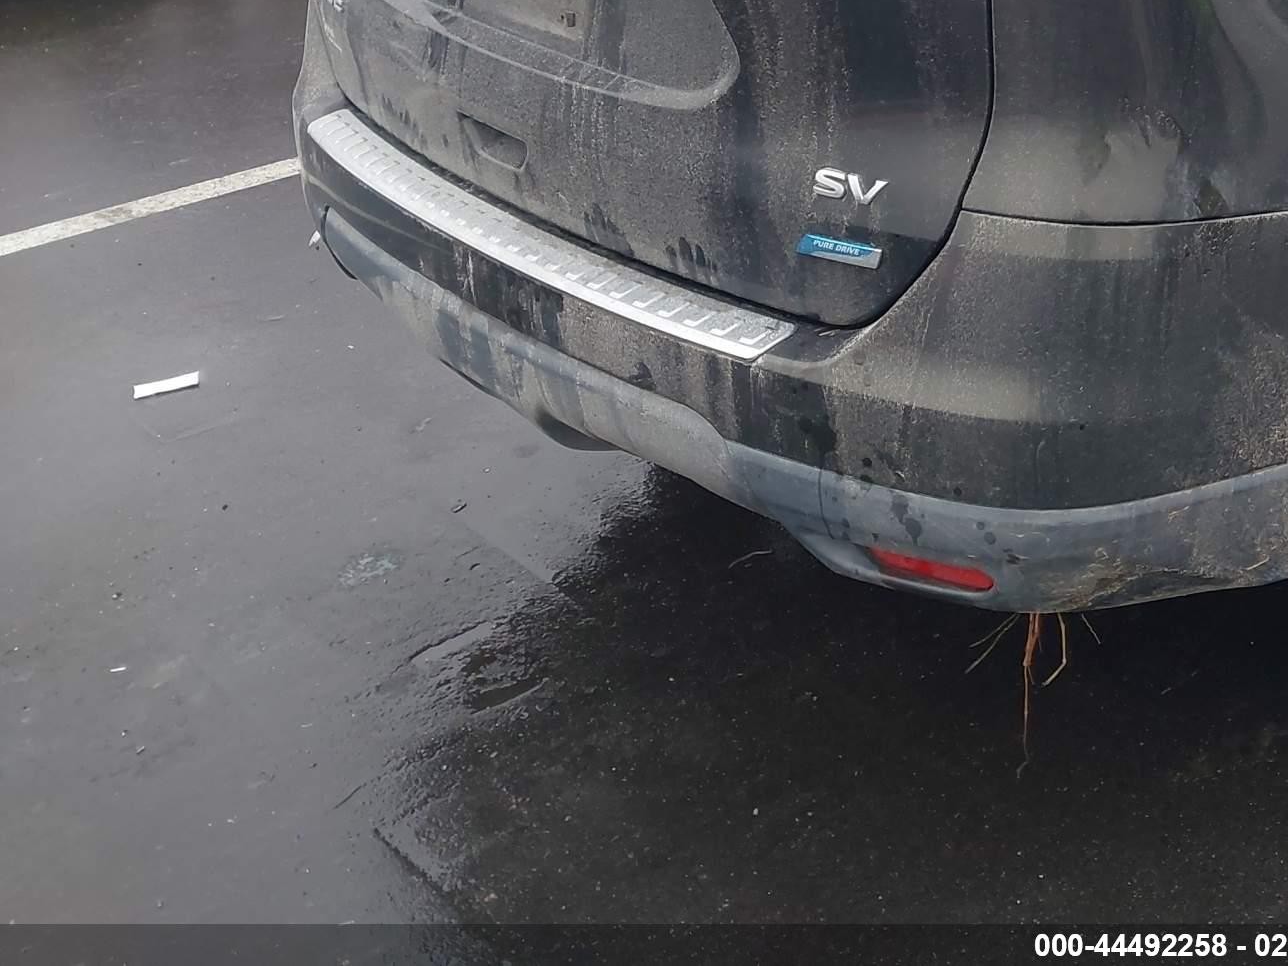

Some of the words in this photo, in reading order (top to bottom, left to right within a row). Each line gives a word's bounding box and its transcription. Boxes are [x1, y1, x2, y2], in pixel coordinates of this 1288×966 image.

[813, 166, 889, 205] SV
[812, 238, 835, 251] PURE
[835, 242, 861, 256] DRIVE
